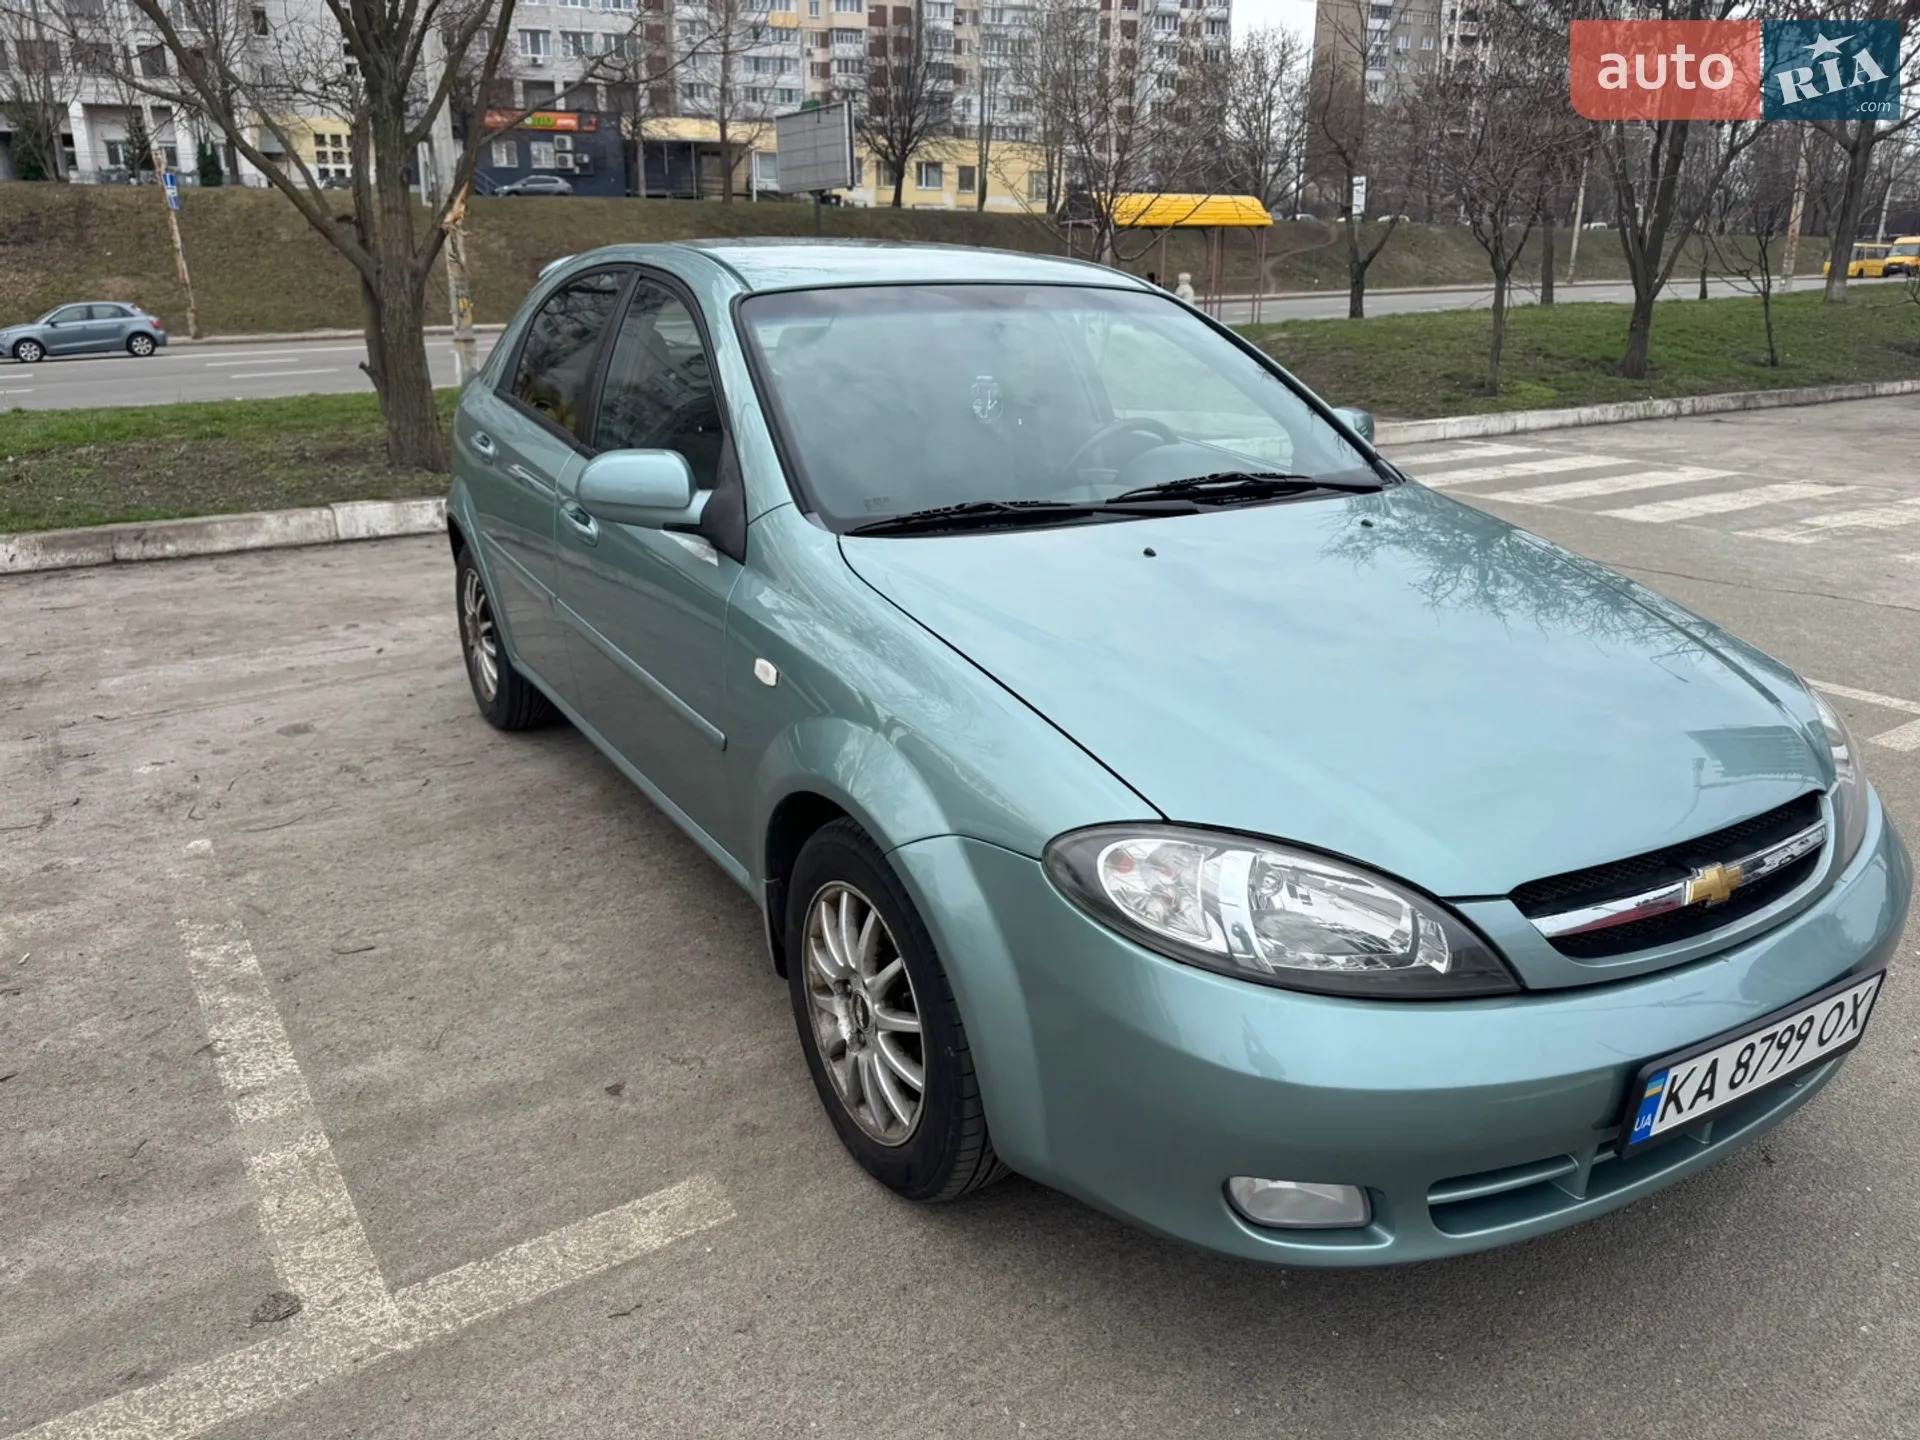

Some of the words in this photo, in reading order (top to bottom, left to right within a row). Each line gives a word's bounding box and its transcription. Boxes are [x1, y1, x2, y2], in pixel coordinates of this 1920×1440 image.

[1660, 1057, 1719, 1122] KA
[1728, 1014, 1815, 1090] 8799
[1817, 986, 1873, 1047] OX
[1634, 1115, 1652, 1132] UA
